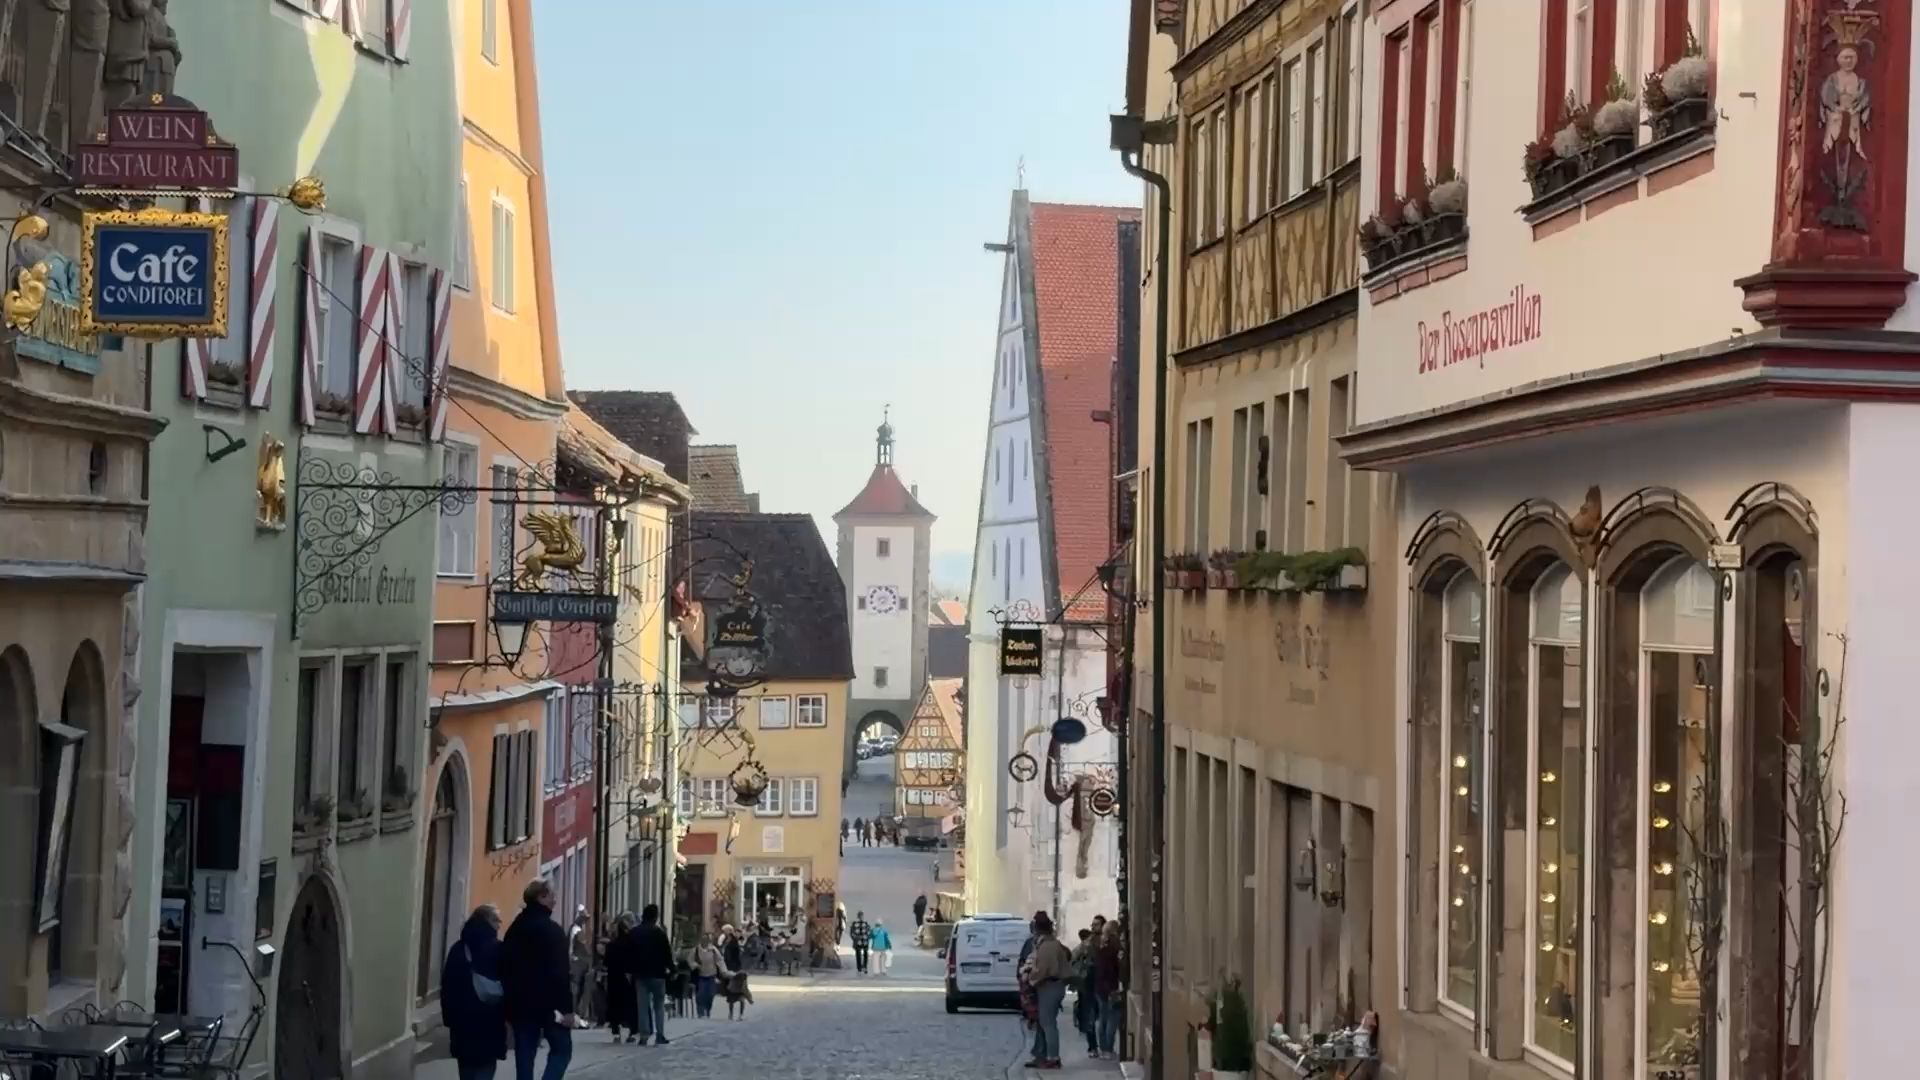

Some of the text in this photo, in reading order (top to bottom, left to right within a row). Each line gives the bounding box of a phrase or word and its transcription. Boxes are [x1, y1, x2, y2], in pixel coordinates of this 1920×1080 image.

[117, 114, 196, 141] WEIN
[81, 152, 232, 179] RESTAURANT
[110, 242, 199, 284] Cafe
[103, 285, 202, 306] CONDITOREI
[1418, 283, 1541, 375] Der Rosenpavillon
[495, 595, 553, 617] Gasthof
